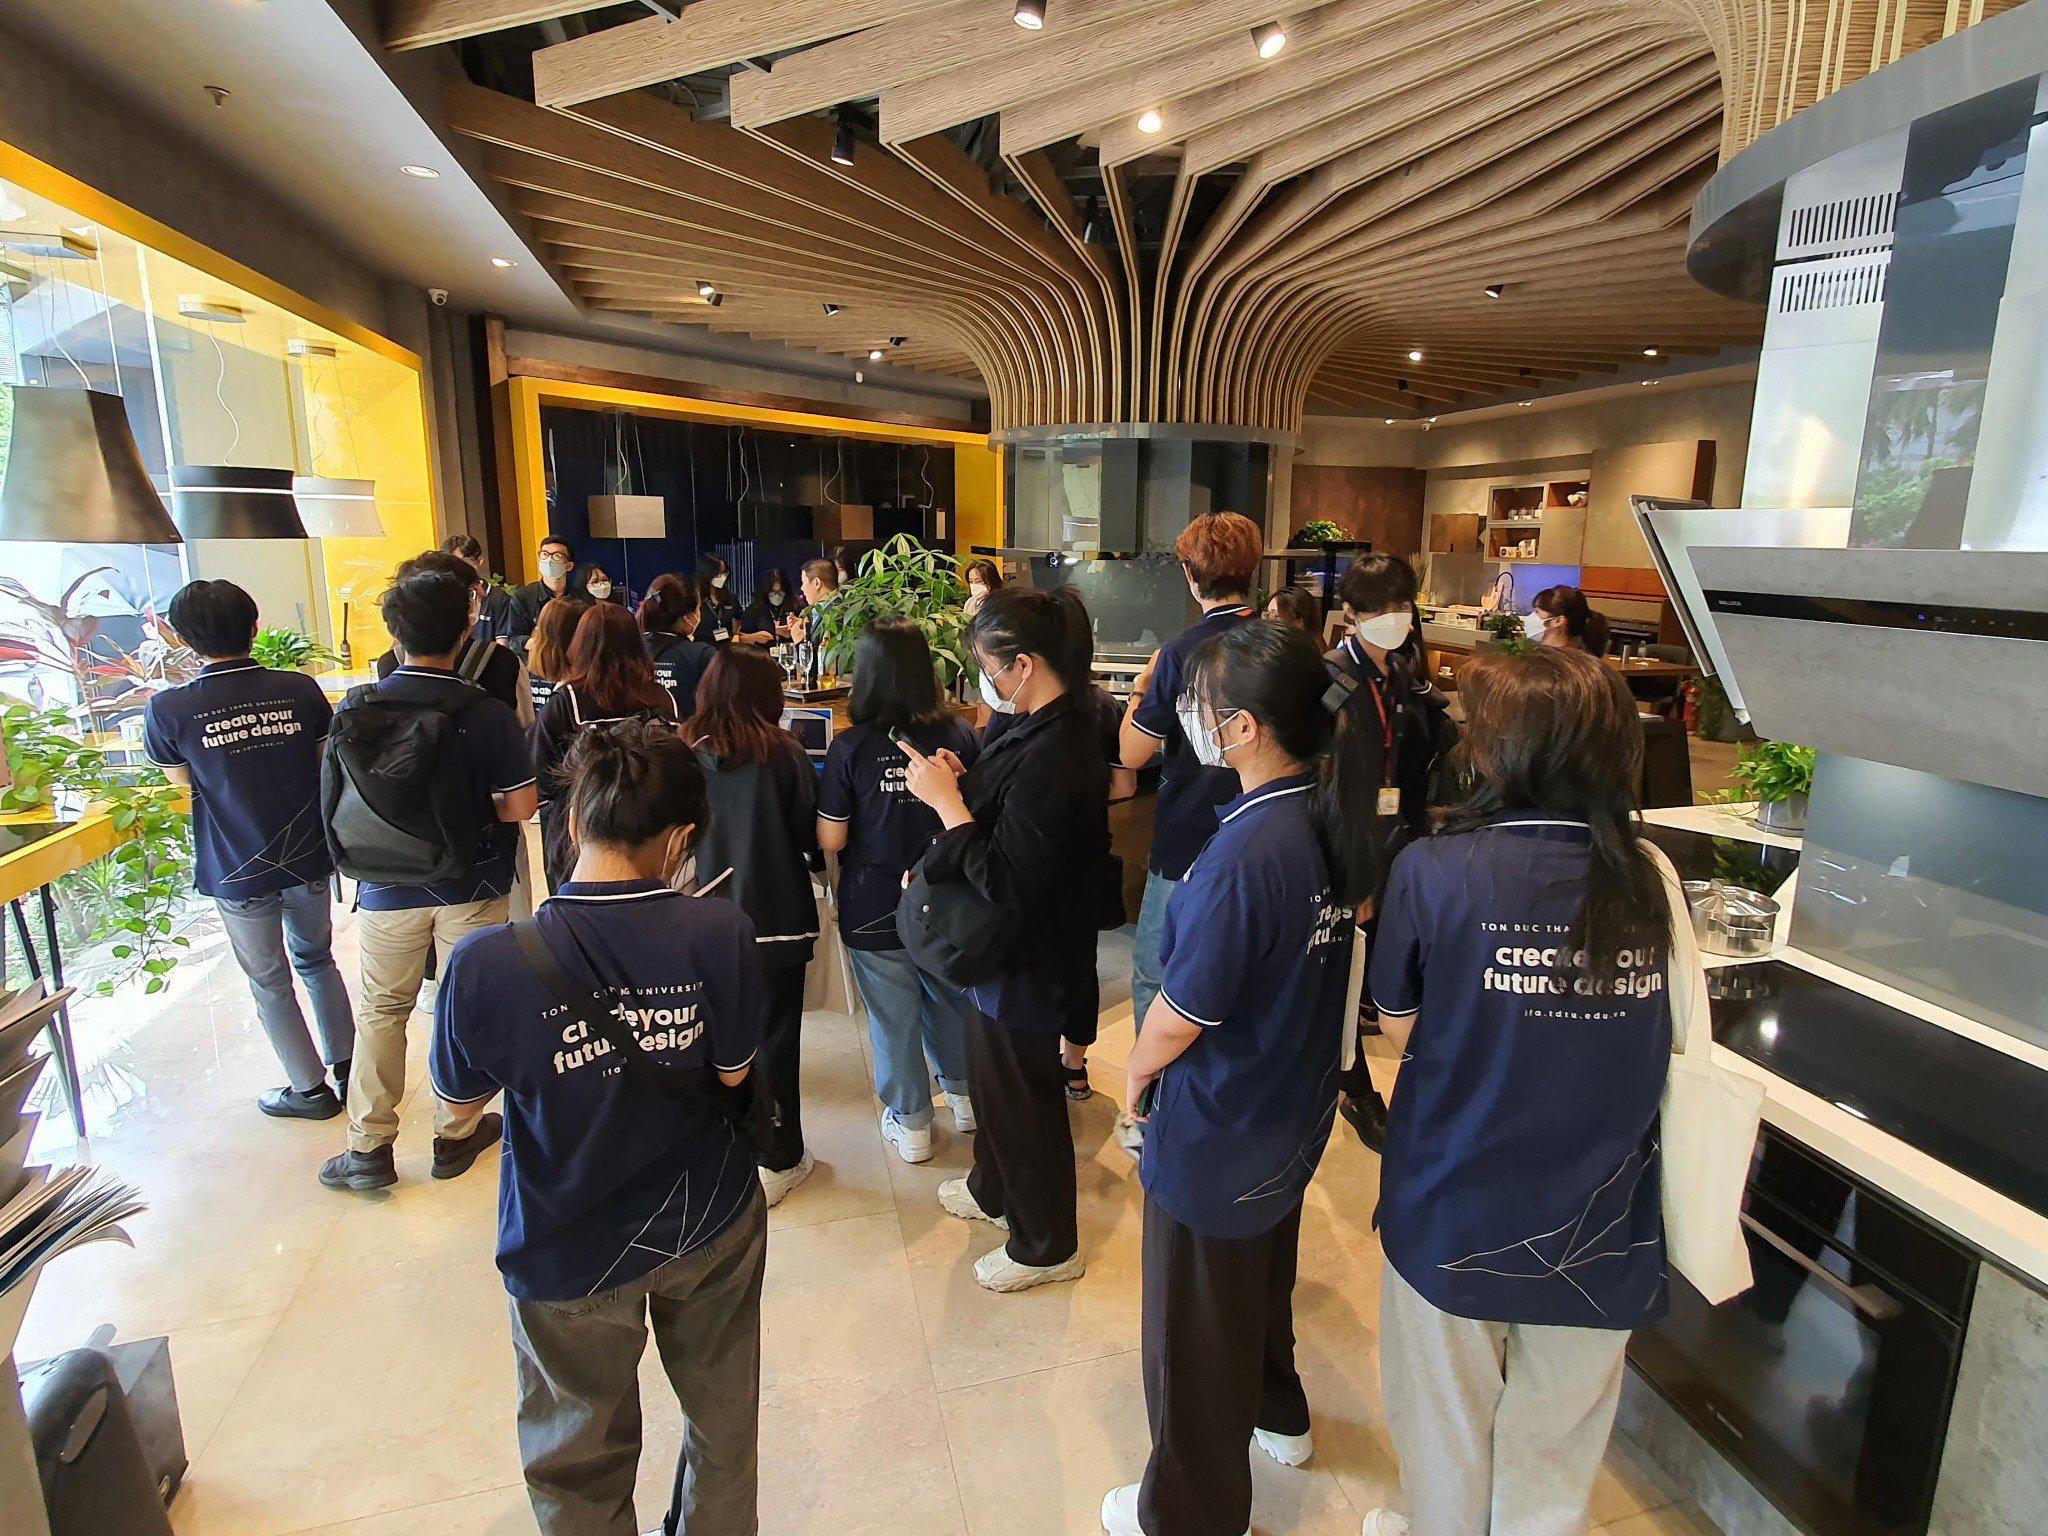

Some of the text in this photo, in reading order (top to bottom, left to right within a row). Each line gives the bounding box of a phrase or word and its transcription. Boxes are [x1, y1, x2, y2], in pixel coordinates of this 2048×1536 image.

[201, 721, 302, 748] future design
[205, 709, 293, 734] create your
[1480, 922, 1507, 932] TON
[1514, 924, 1539, 933] DUC
[541, 1004, 568, 1019] TON
[637, 1003, 698, 1032] your
[632, 1020, 704, 1051] esign
